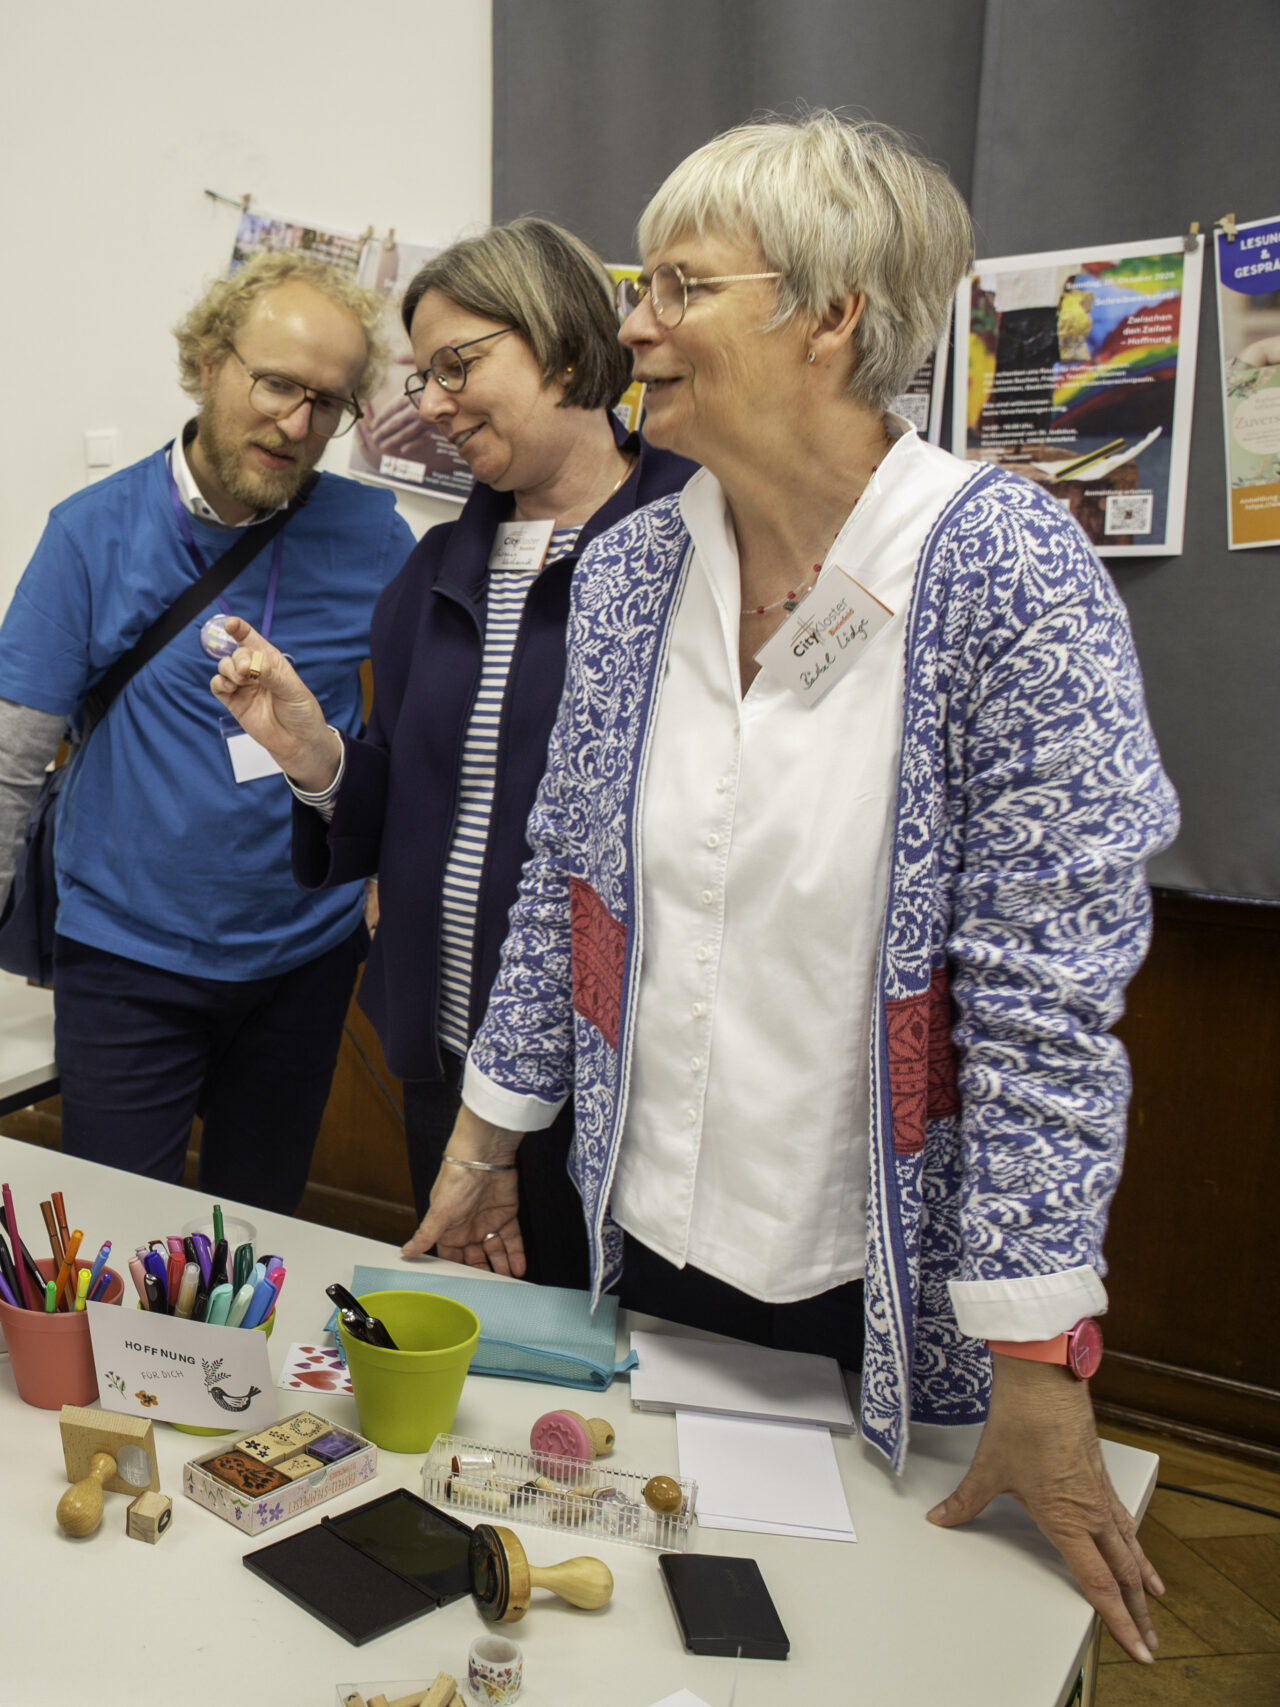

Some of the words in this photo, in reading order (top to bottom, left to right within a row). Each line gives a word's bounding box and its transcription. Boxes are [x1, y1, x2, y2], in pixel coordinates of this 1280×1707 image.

[1240, 231, 1280, 250] LESUN
[1260, 248, 1271, 260] &
[1127, 314, 1173, 325] Zwischen
[1122, 326, 1141, 336] den
[1127, 335, 1172, 346] Hoffnung
[124, 1340, 196, 1365] HOFFNUNG
[161, 1369, 185, 1379] DICH
